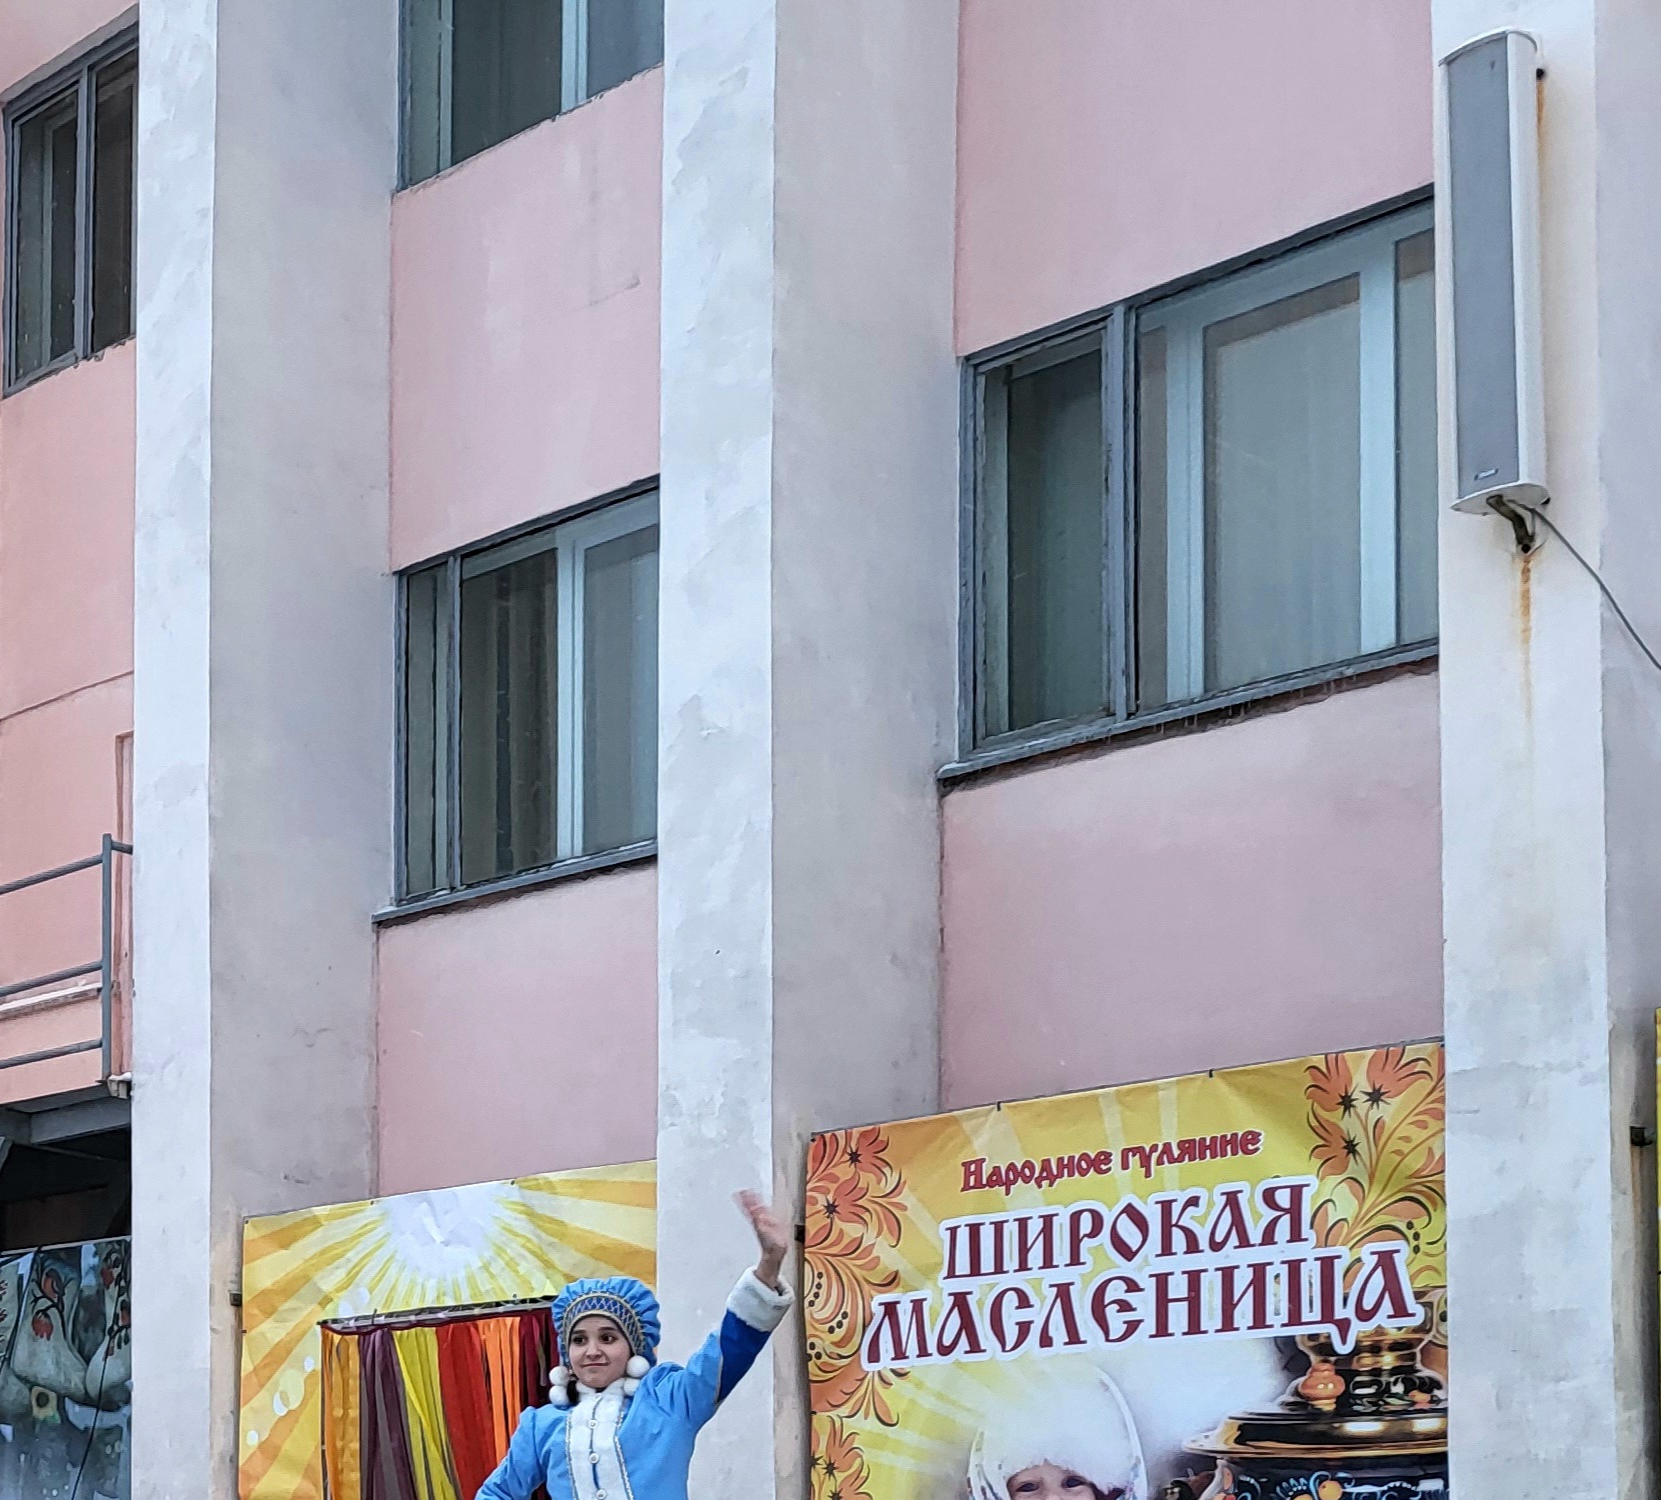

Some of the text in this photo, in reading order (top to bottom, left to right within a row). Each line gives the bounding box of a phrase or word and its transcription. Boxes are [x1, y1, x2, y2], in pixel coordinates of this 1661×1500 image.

[960, 1130, 1262, 1196] Народное гуляние
[943, 1183, 1312, 1280] ШИРОКАЯ
[868, 1249, 1416, 1363] МАСЛЕНИЦА
